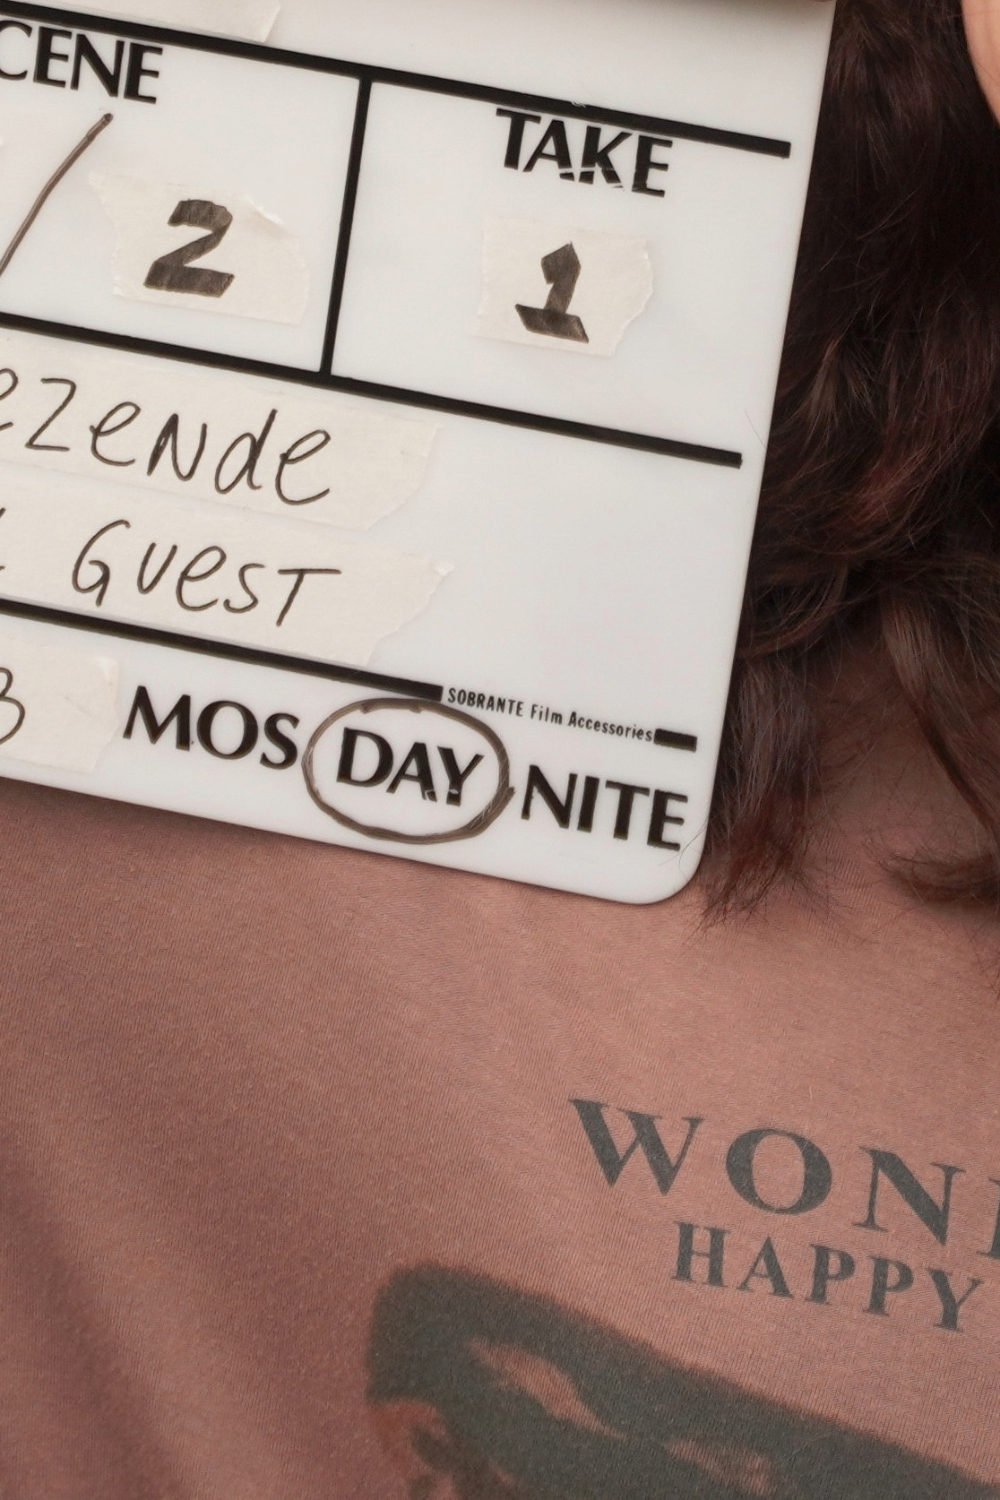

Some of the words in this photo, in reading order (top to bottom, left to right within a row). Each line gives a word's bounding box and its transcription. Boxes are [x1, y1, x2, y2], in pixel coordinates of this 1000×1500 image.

[496, 108, 673, 197] TAKE
[143, 200, 235, 298] 2
[514, 242, 589, 344] 1
[447, 687, 525, 717] SOBRANTE
[530, 704, 563, 726] Film
[568, 711, 654, 742] Accessories
[122, 685, 299, 770] MOS
[335, 727, 484, 807] DAY
[521, 764, 690, 851] NITE
[670, 1220, 984, 1333] HAPPY
